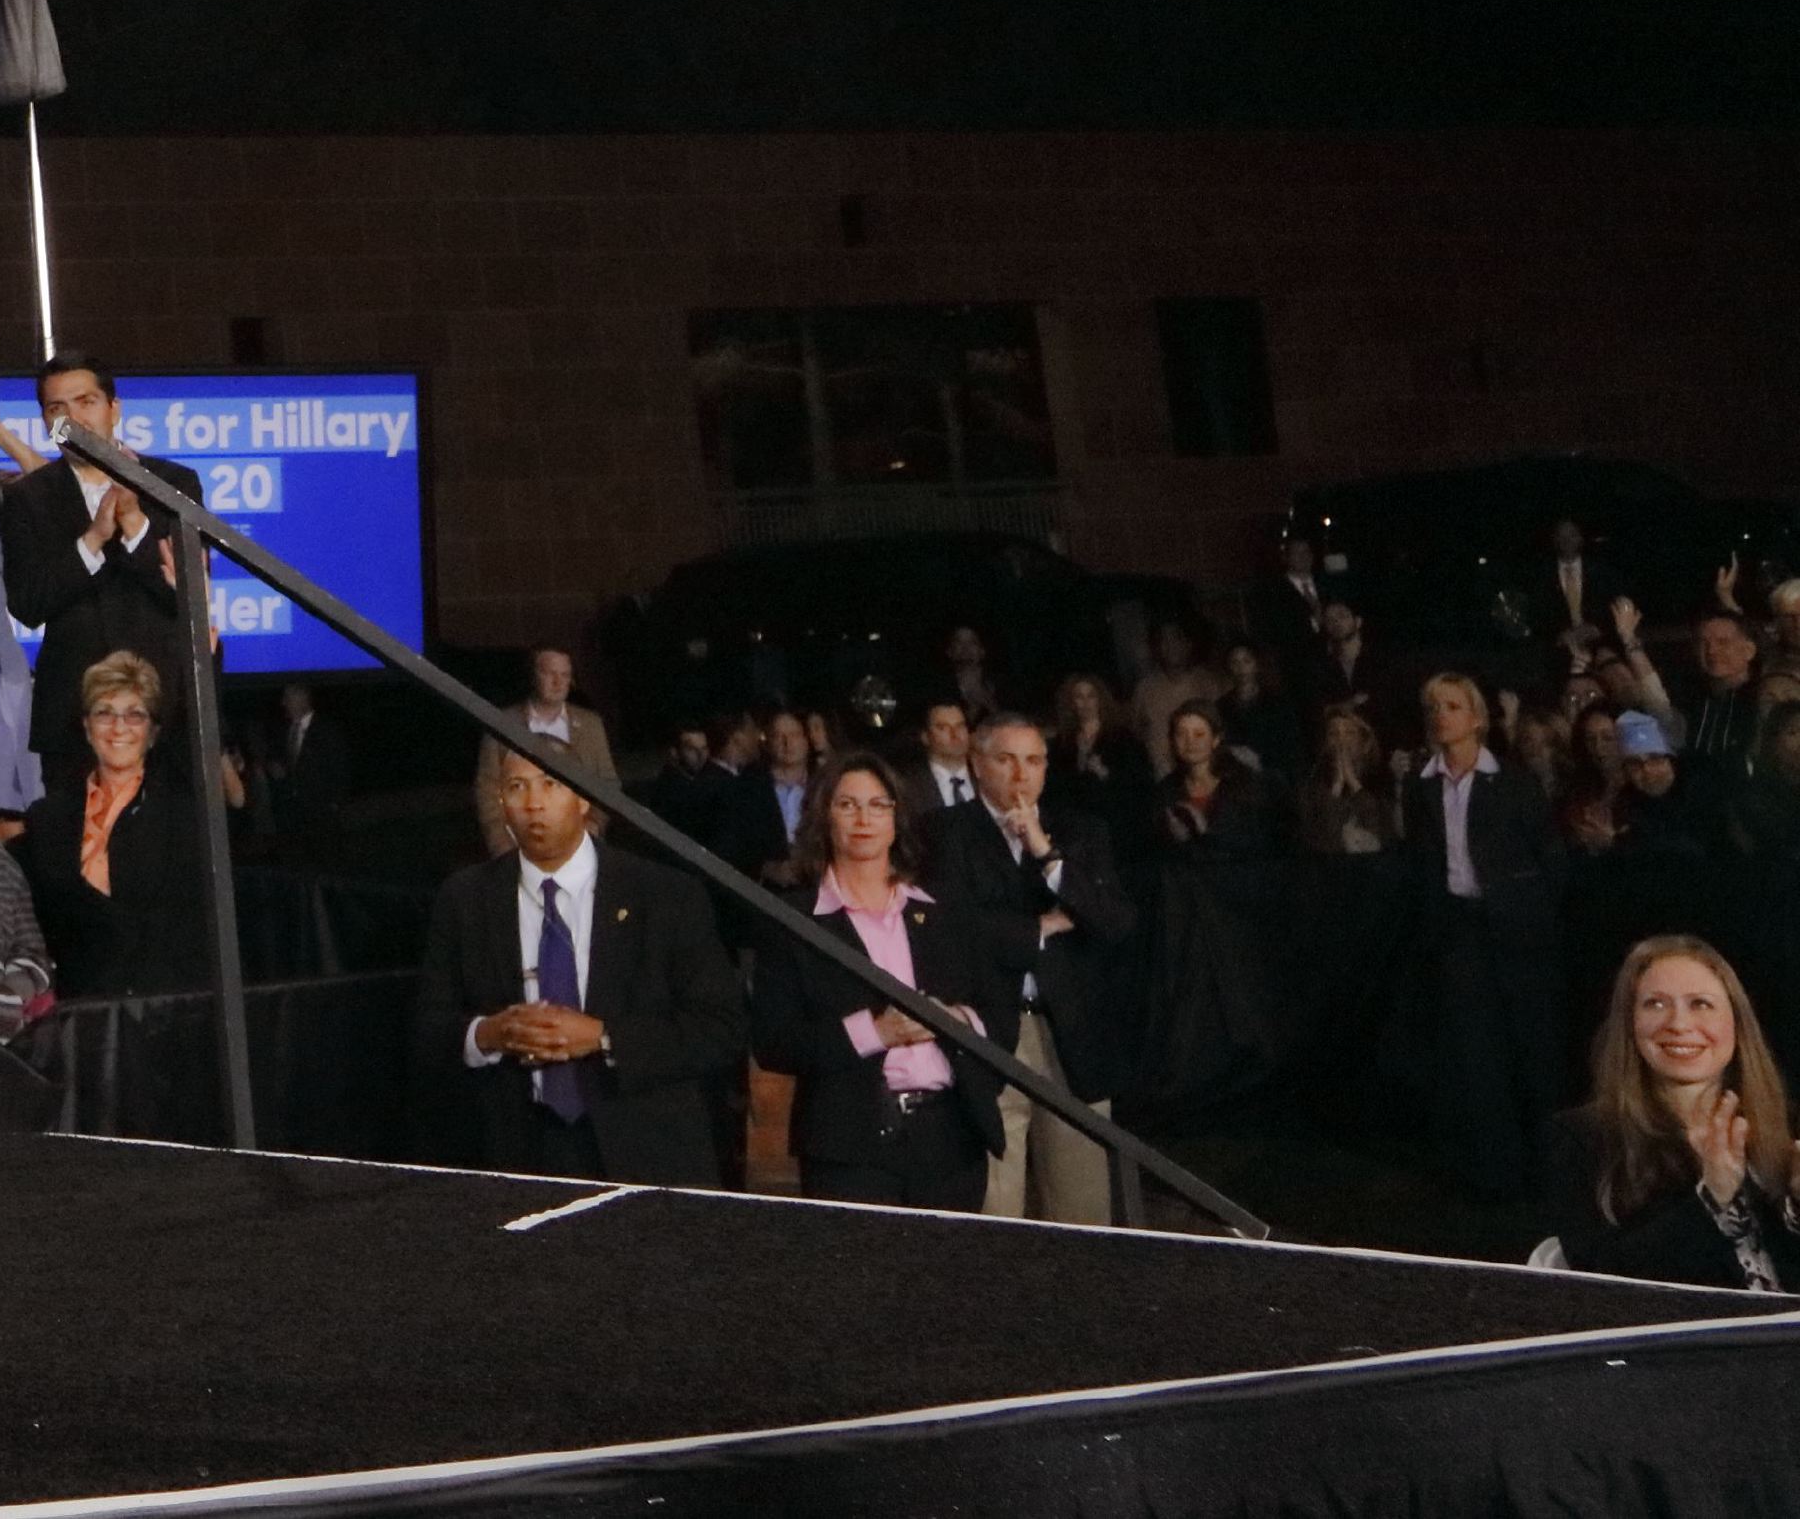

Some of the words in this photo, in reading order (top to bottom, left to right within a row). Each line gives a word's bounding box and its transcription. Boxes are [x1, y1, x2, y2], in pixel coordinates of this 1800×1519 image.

[165, 402, 238, 449] for
[252, 399, 408, 458] Hillary
[209, 464, 272, 510] 20
